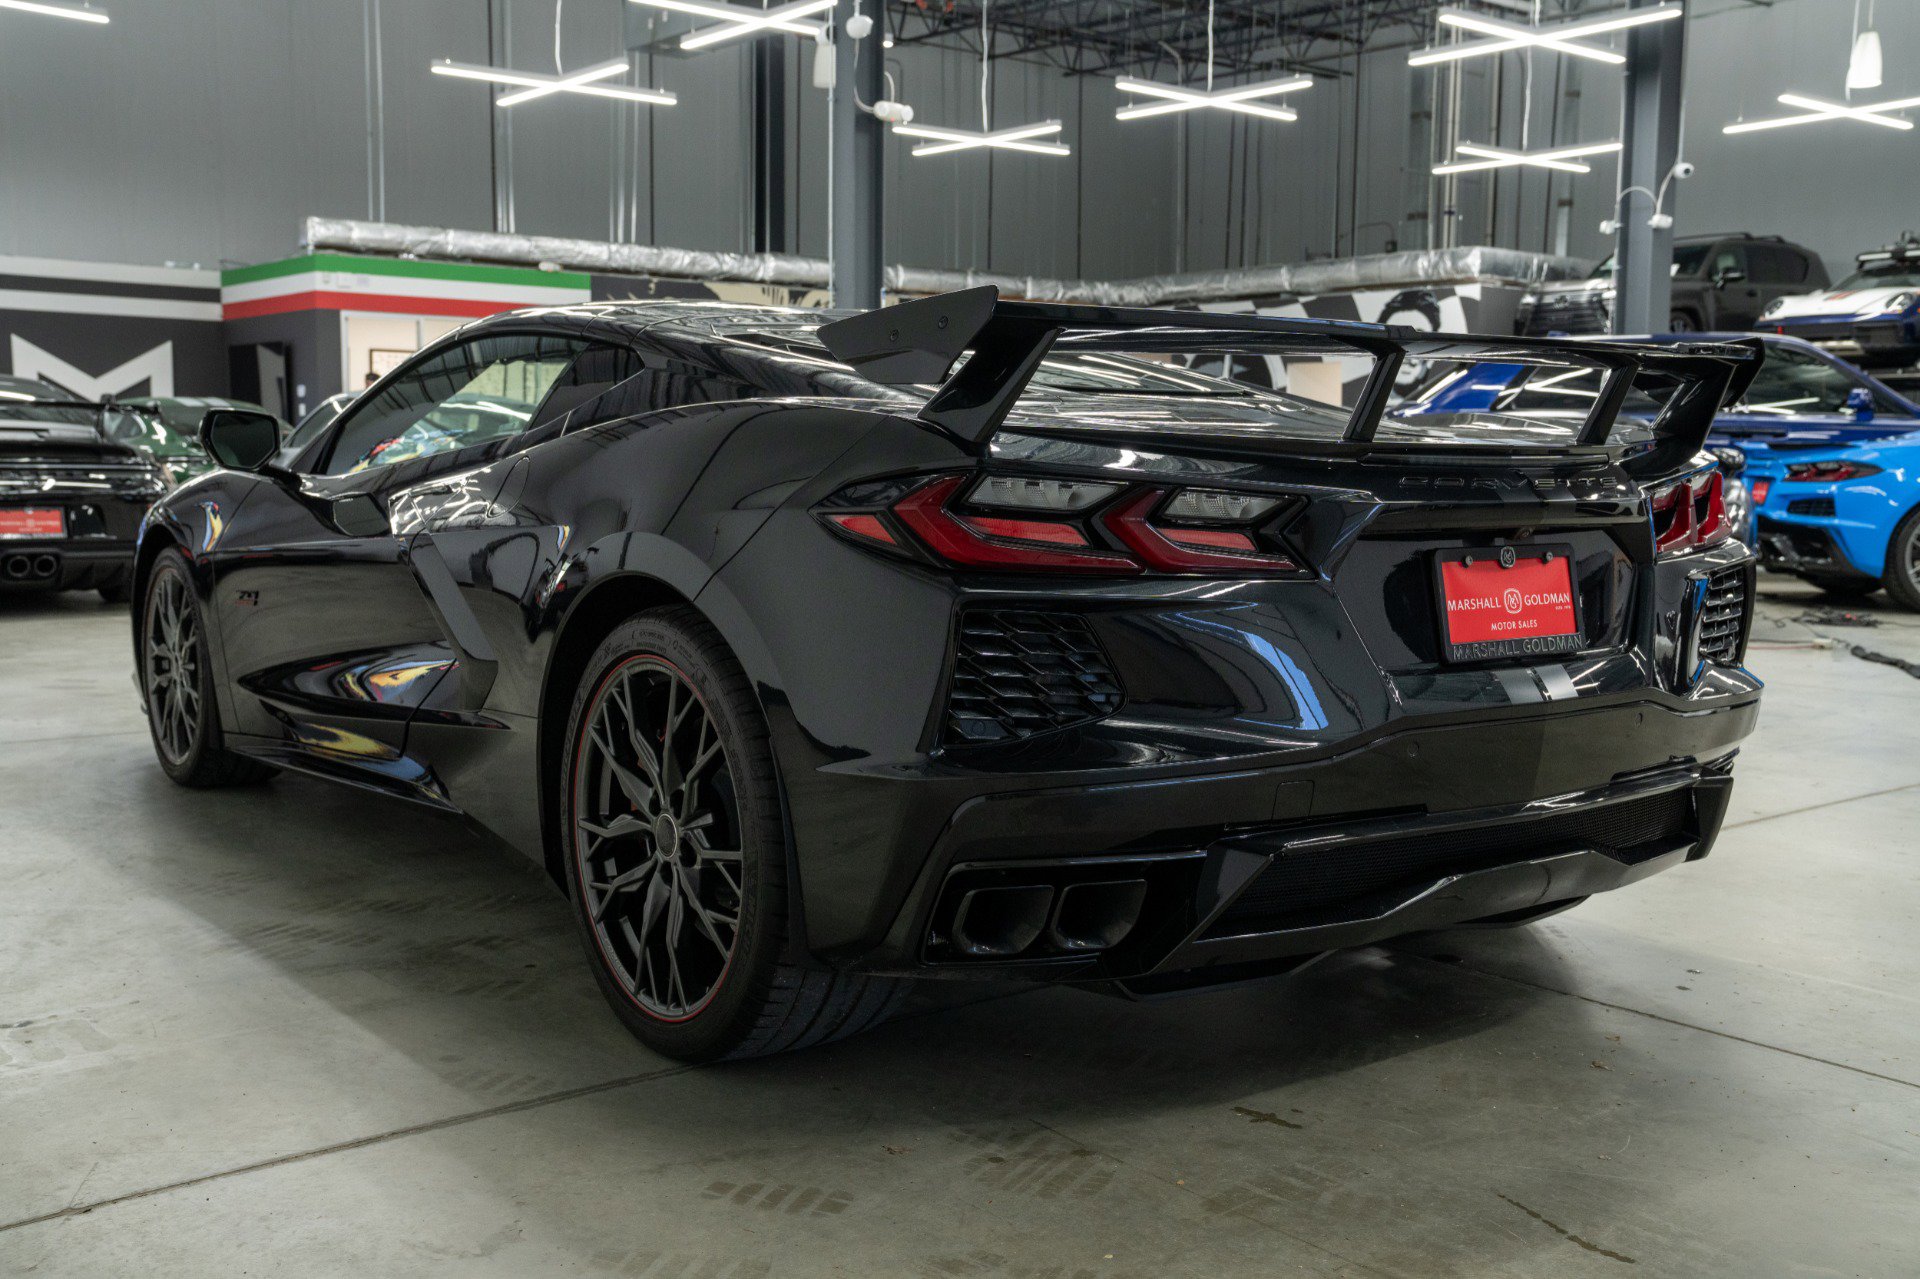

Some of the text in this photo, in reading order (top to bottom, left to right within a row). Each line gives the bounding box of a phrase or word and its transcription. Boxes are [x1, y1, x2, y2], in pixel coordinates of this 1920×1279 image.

[1447, 598, 1501, 612] MARSHALL
[1524, 593, 1570, 606] GOLDMAN
[1491, 619, 1538, 631] MOTOR SALES
[1453, 635, 1582, 660] MARSHALL GOLDMAN
